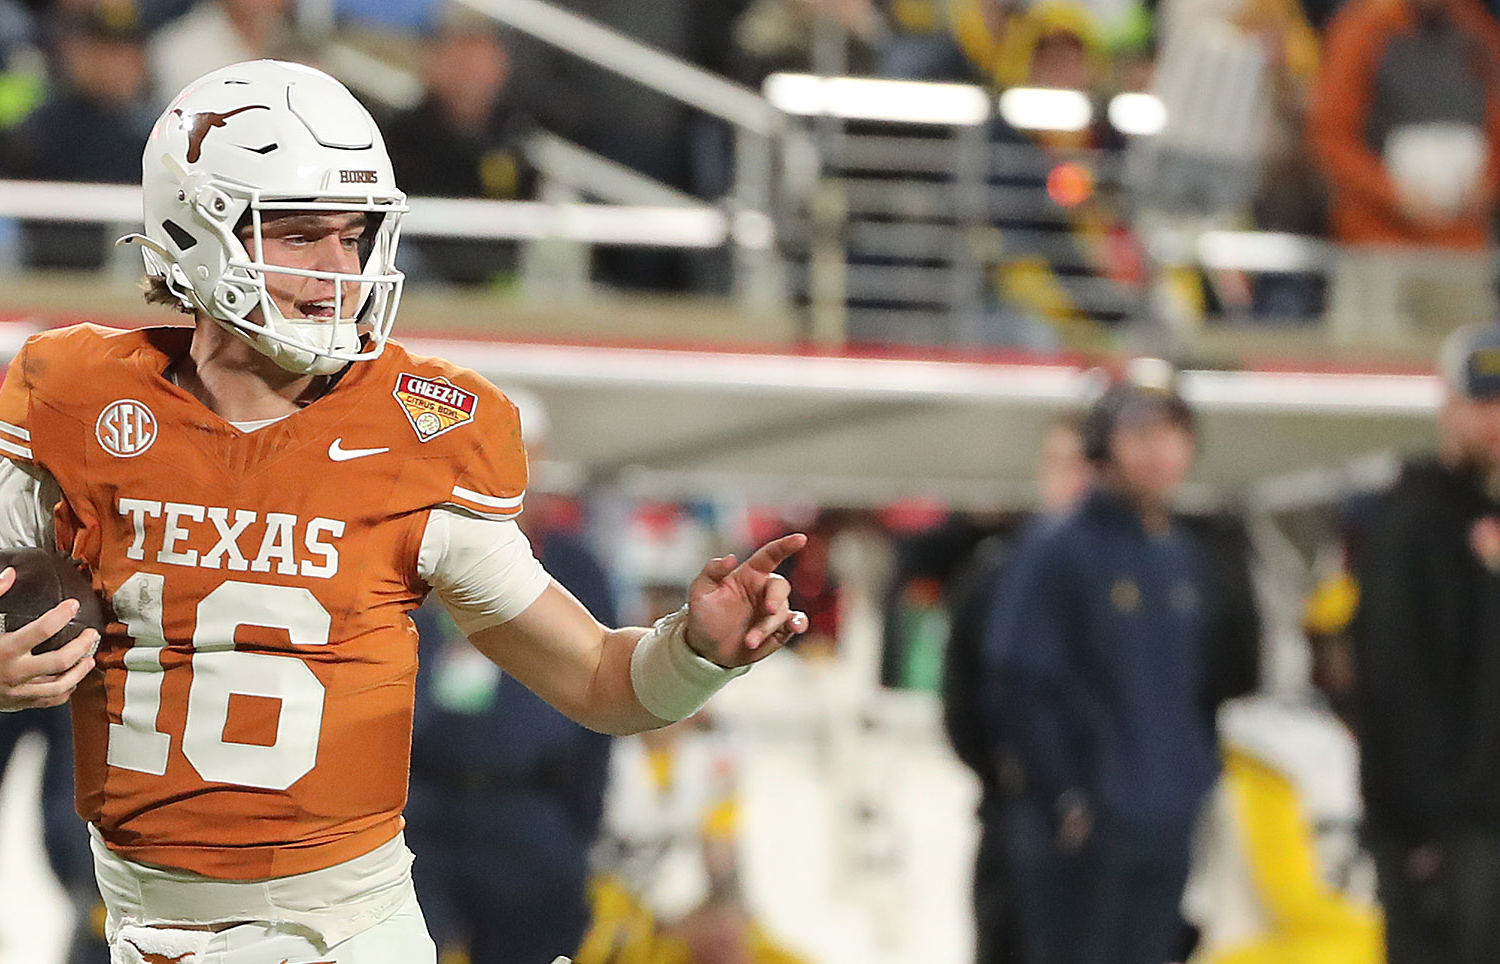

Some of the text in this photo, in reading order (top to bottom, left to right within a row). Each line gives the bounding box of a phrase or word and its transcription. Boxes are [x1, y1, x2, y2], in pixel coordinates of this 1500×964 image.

[102, 404, 152, 453] SEC
[119, 498, 346, 579] TEXAS
[106, 571, 332, 791] 16
